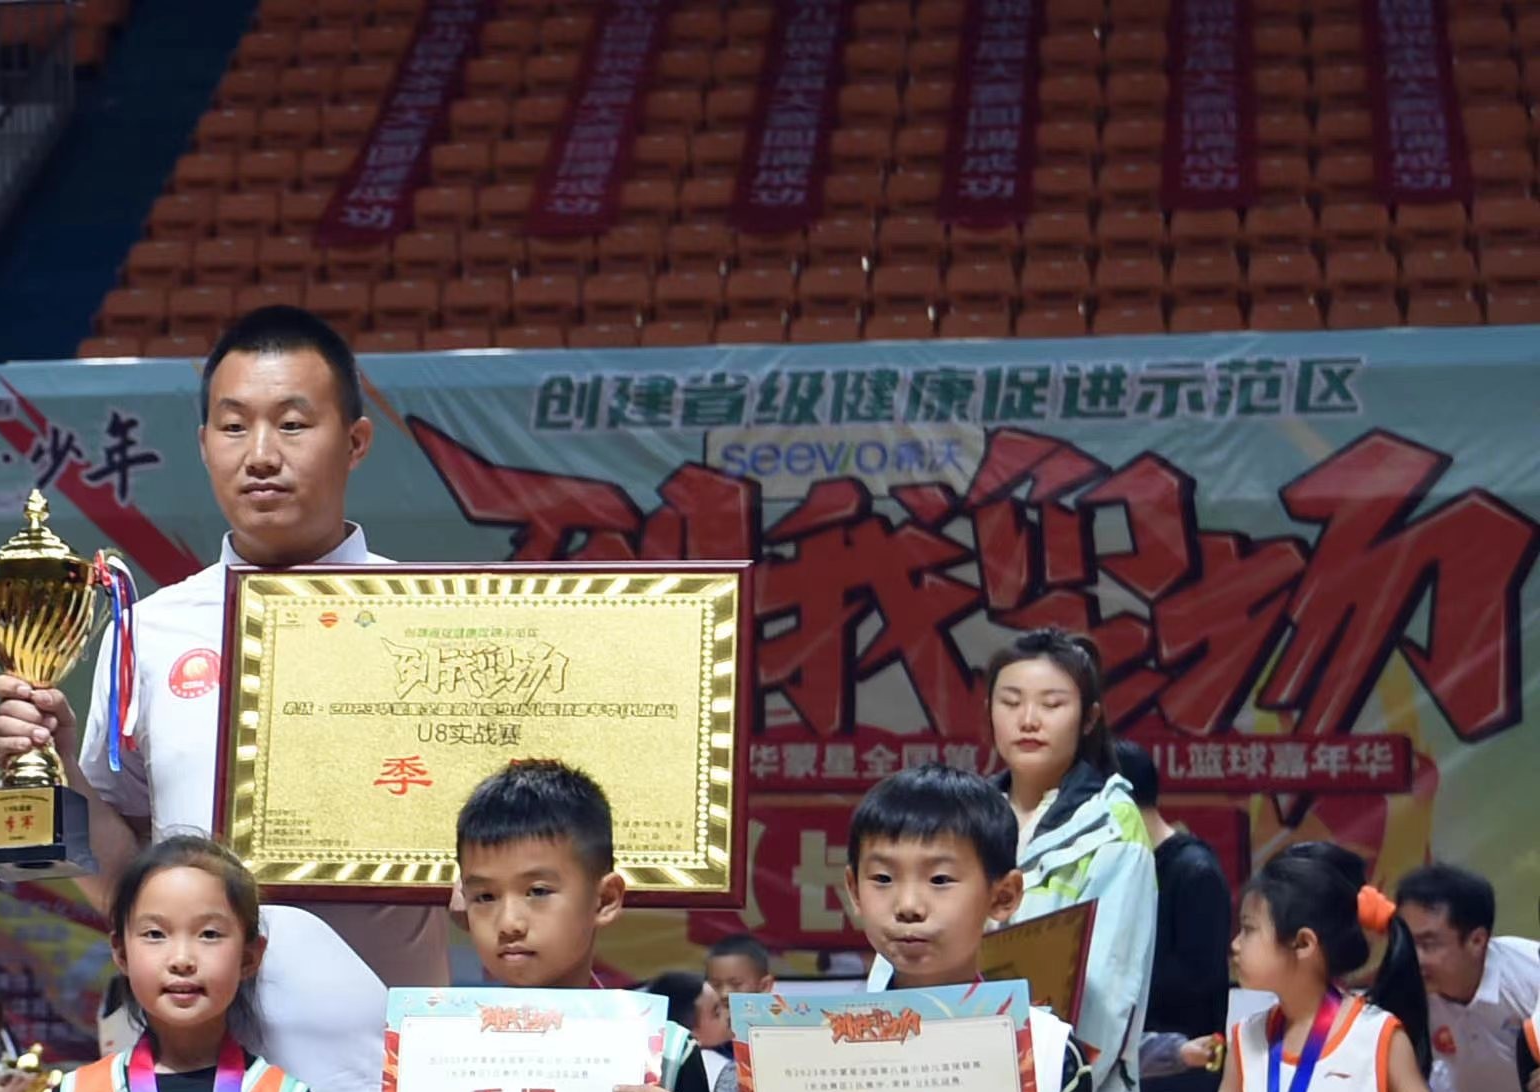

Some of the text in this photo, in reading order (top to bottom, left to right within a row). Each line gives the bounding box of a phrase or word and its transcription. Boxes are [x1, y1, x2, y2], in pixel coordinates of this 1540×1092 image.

[533, 356, 1365, 431] 创建省级健康促进示范区
[417, 721, 523, 747] U8实战赛
